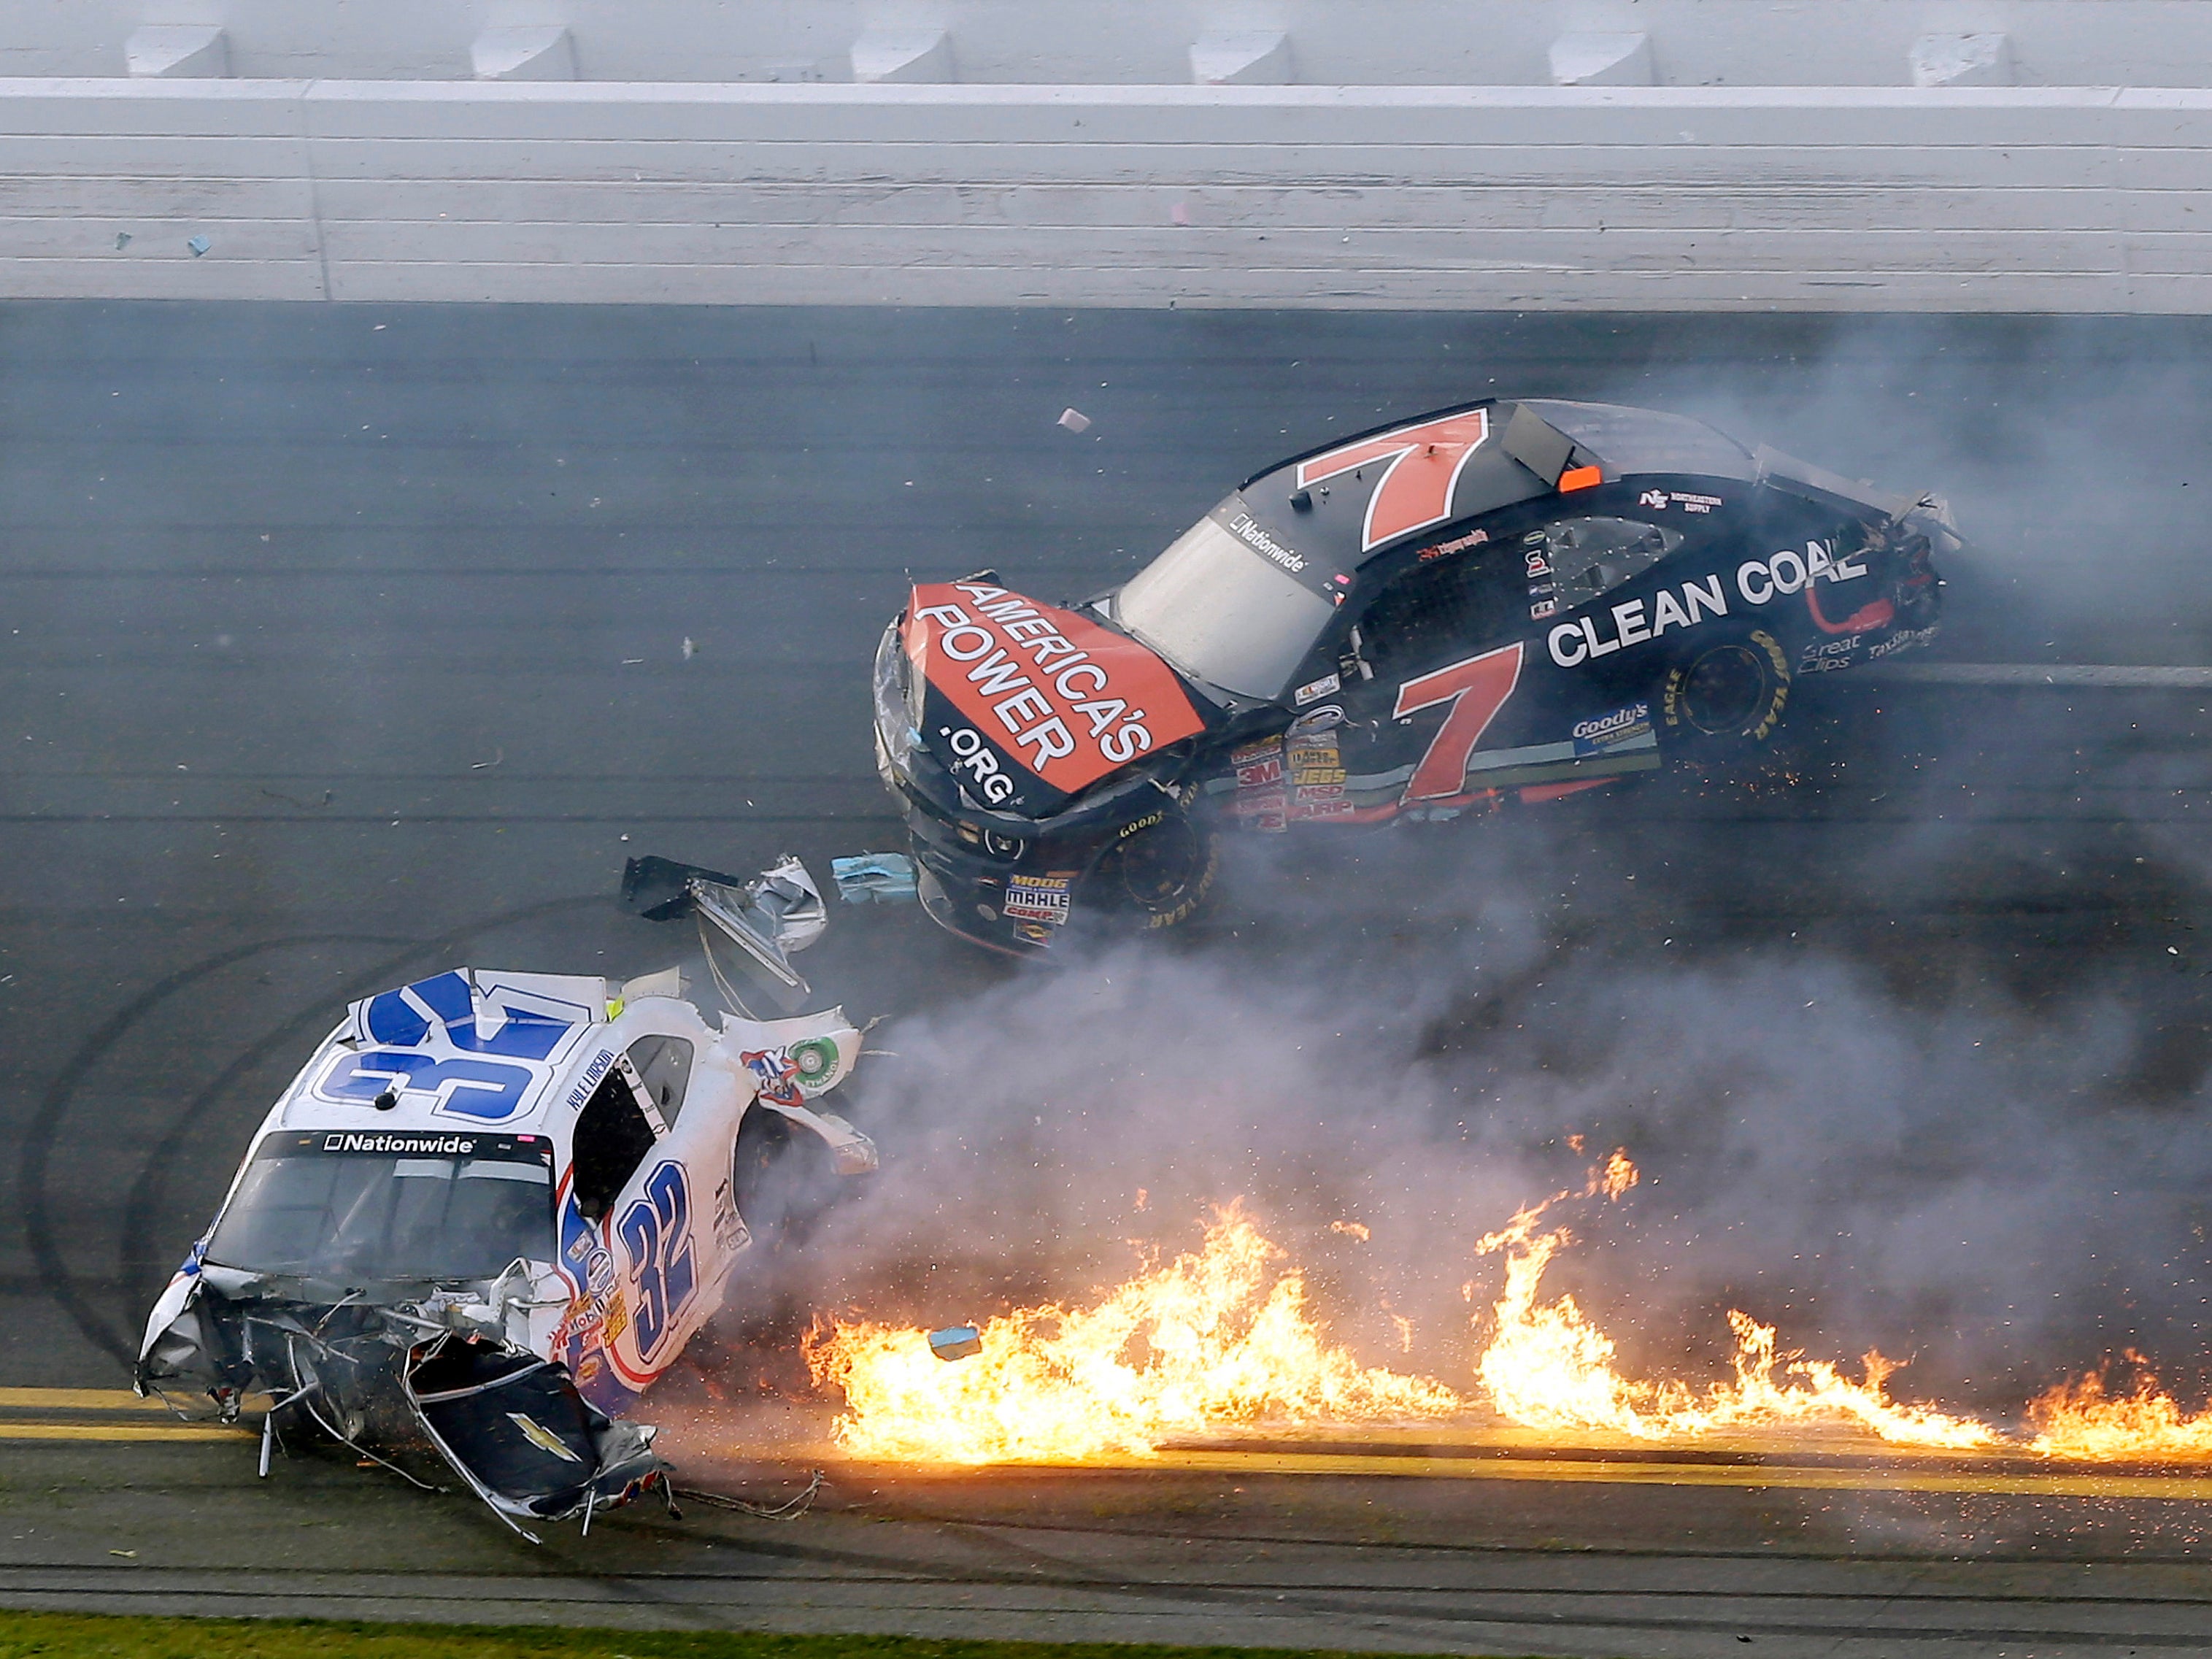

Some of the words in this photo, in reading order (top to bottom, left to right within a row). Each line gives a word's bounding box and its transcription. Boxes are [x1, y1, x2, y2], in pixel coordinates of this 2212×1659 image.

[1296, 407, 1489, 553] 7
[1237, 520, 1305, 572] Nationwide
[1548, 575, 1727, 667] CLEAN
[1737, 539, 1868, 605] COAL
[914, 604, 1075, 771] POWER
[957, 584, 1152, 763] AMERICA'S
[1392, 640, 1524, 806] 7
[1573, 704, 1648, 738] Goody's
[1238, 761, 1280, 785] 3M
[1294, 769, 1346, 784] JEGS
[1008, 890, 1068, 907] MAHLE
[566, 1081, 591, 1111] KYLE
[582, 1049, 614, 1087] LARSON
[343, 1134, 475, 1154] Nationwide
[617, 1160, 698, 1364] 32
